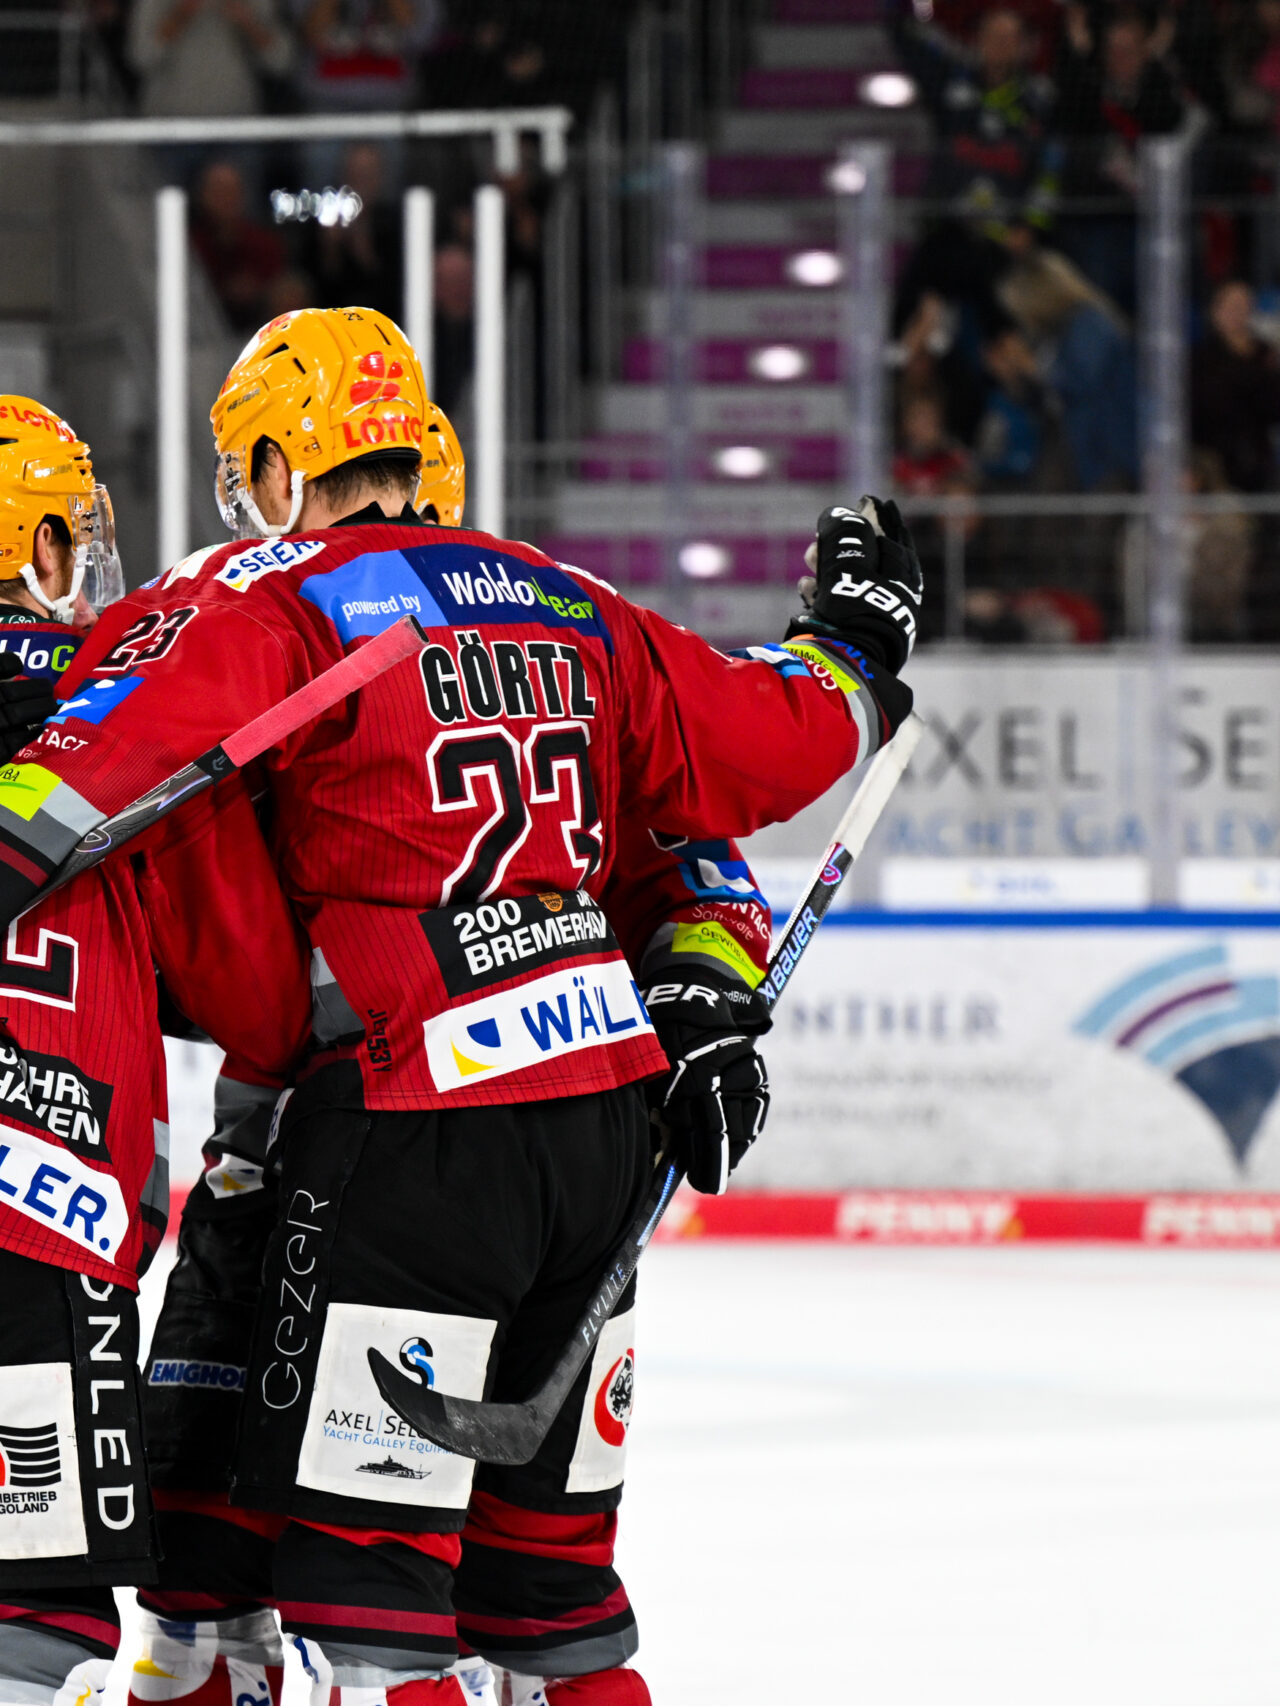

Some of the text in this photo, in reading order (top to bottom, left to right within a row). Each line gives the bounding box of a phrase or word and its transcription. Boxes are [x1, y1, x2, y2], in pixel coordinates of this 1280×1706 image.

[342, 414, 422, 449] LOTTO
[92, 604, 200, 672] 23
[341, 594, 422, 622] powered by
[418, 628, 597, 725] GÖRTZ
[898, 705, 1106, 791] XEL
[426, 719, 604, 908] 23
[452, 898, 522, 945] 200
[769, 904, 820, 992] BAUER
[581, 1262, 626, 1347] FLYLITE
[323, 1425, 360, 1443] YACHT
[363, 1433, 407, 1450] GALLEY
[325, 1409, 374, 1433] AXEL
